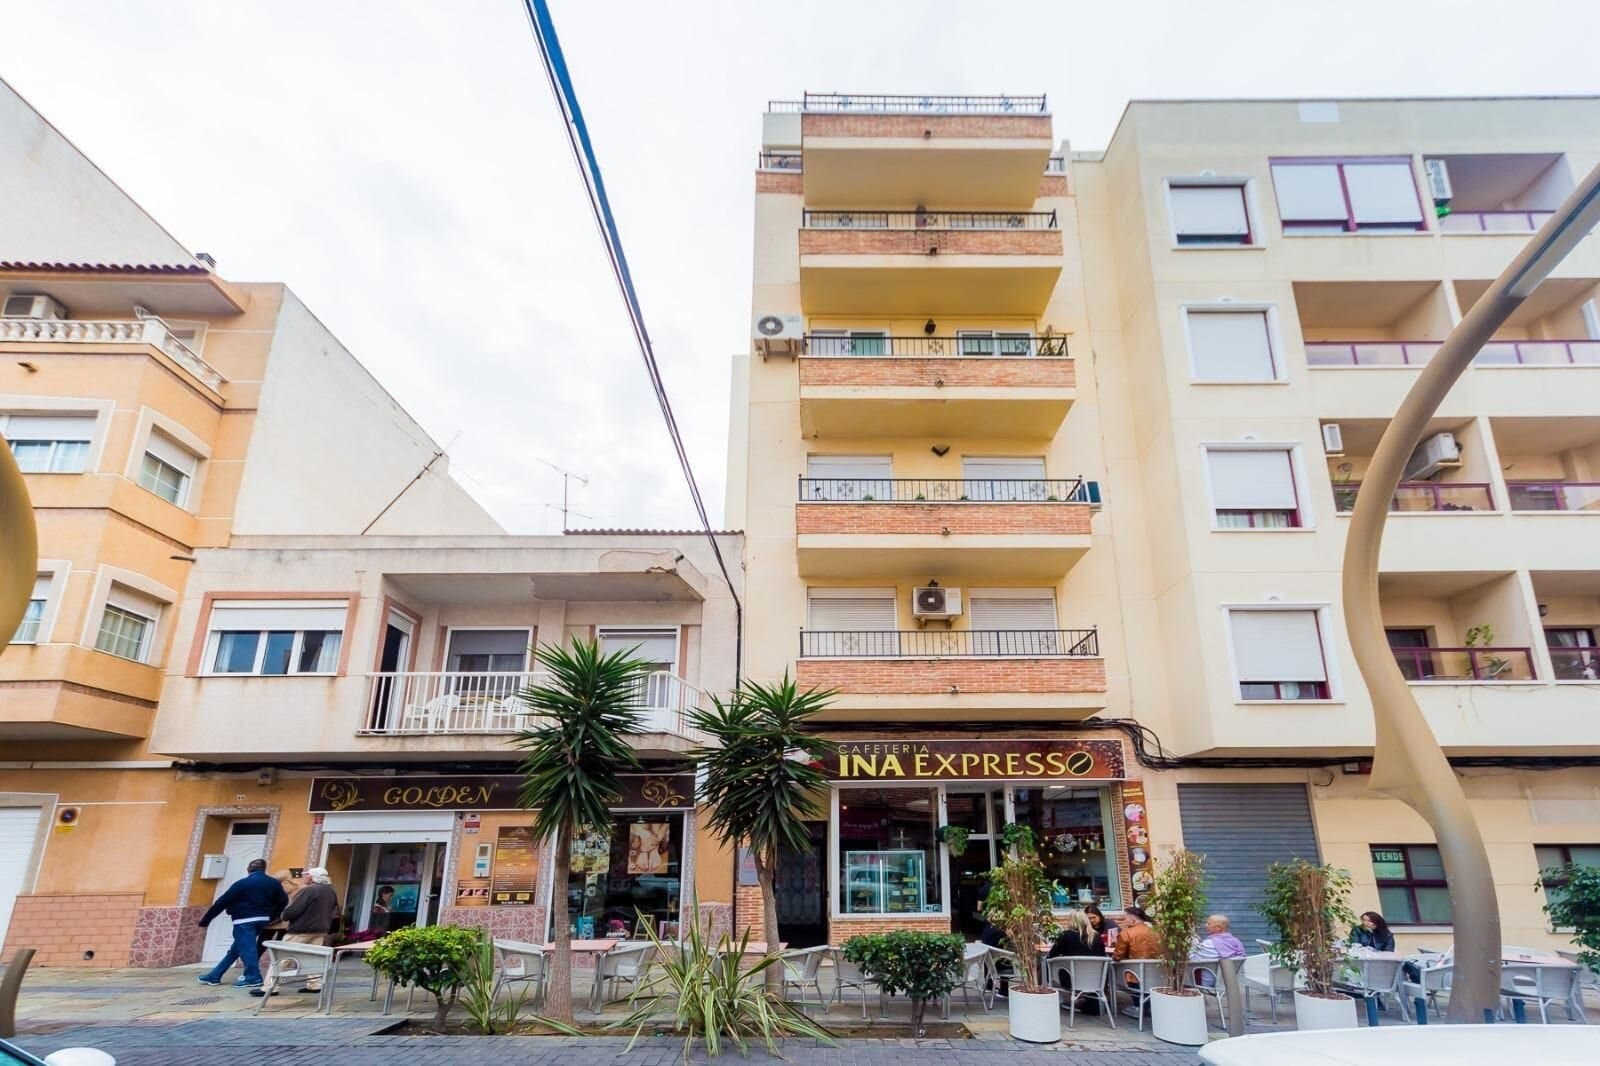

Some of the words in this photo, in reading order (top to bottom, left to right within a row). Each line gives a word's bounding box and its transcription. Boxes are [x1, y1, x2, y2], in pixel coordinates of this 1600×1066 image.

[838, 744, 929, 754] CAFETERIA
[839, 753, 906, 777] INA
[383, 784, 499, 807] GOLDEN
